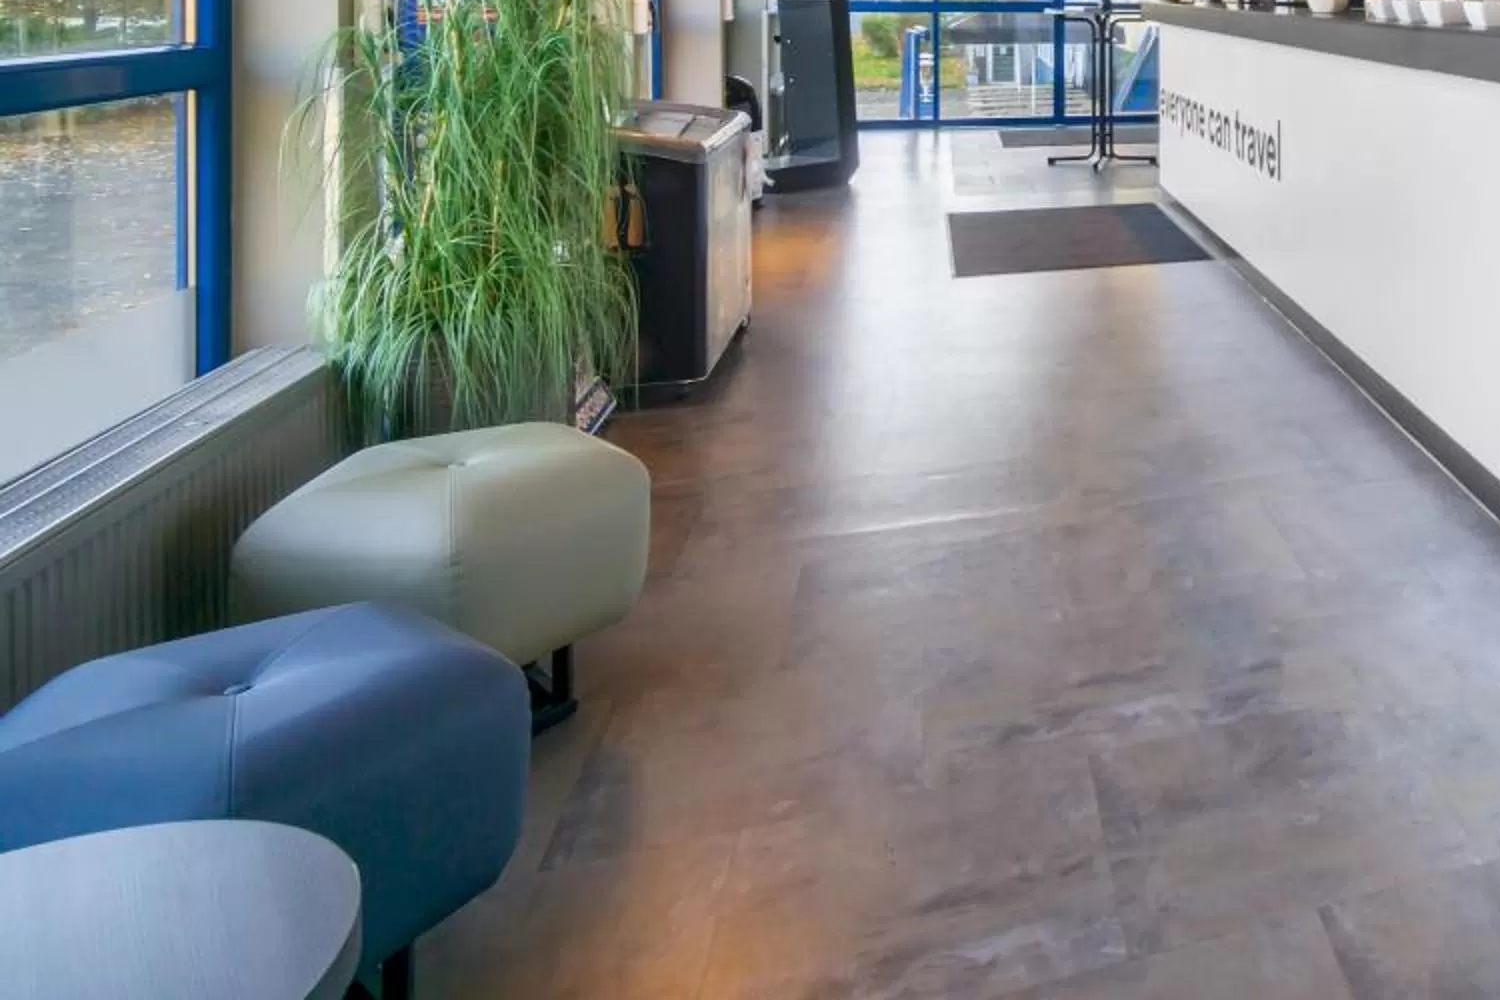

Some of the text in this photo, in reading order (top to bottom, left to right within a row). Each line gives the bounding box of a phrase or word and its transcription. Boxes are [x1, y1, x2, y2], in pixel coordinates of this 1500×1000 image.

[1161, 87, 1281, 182] everyone can travel
